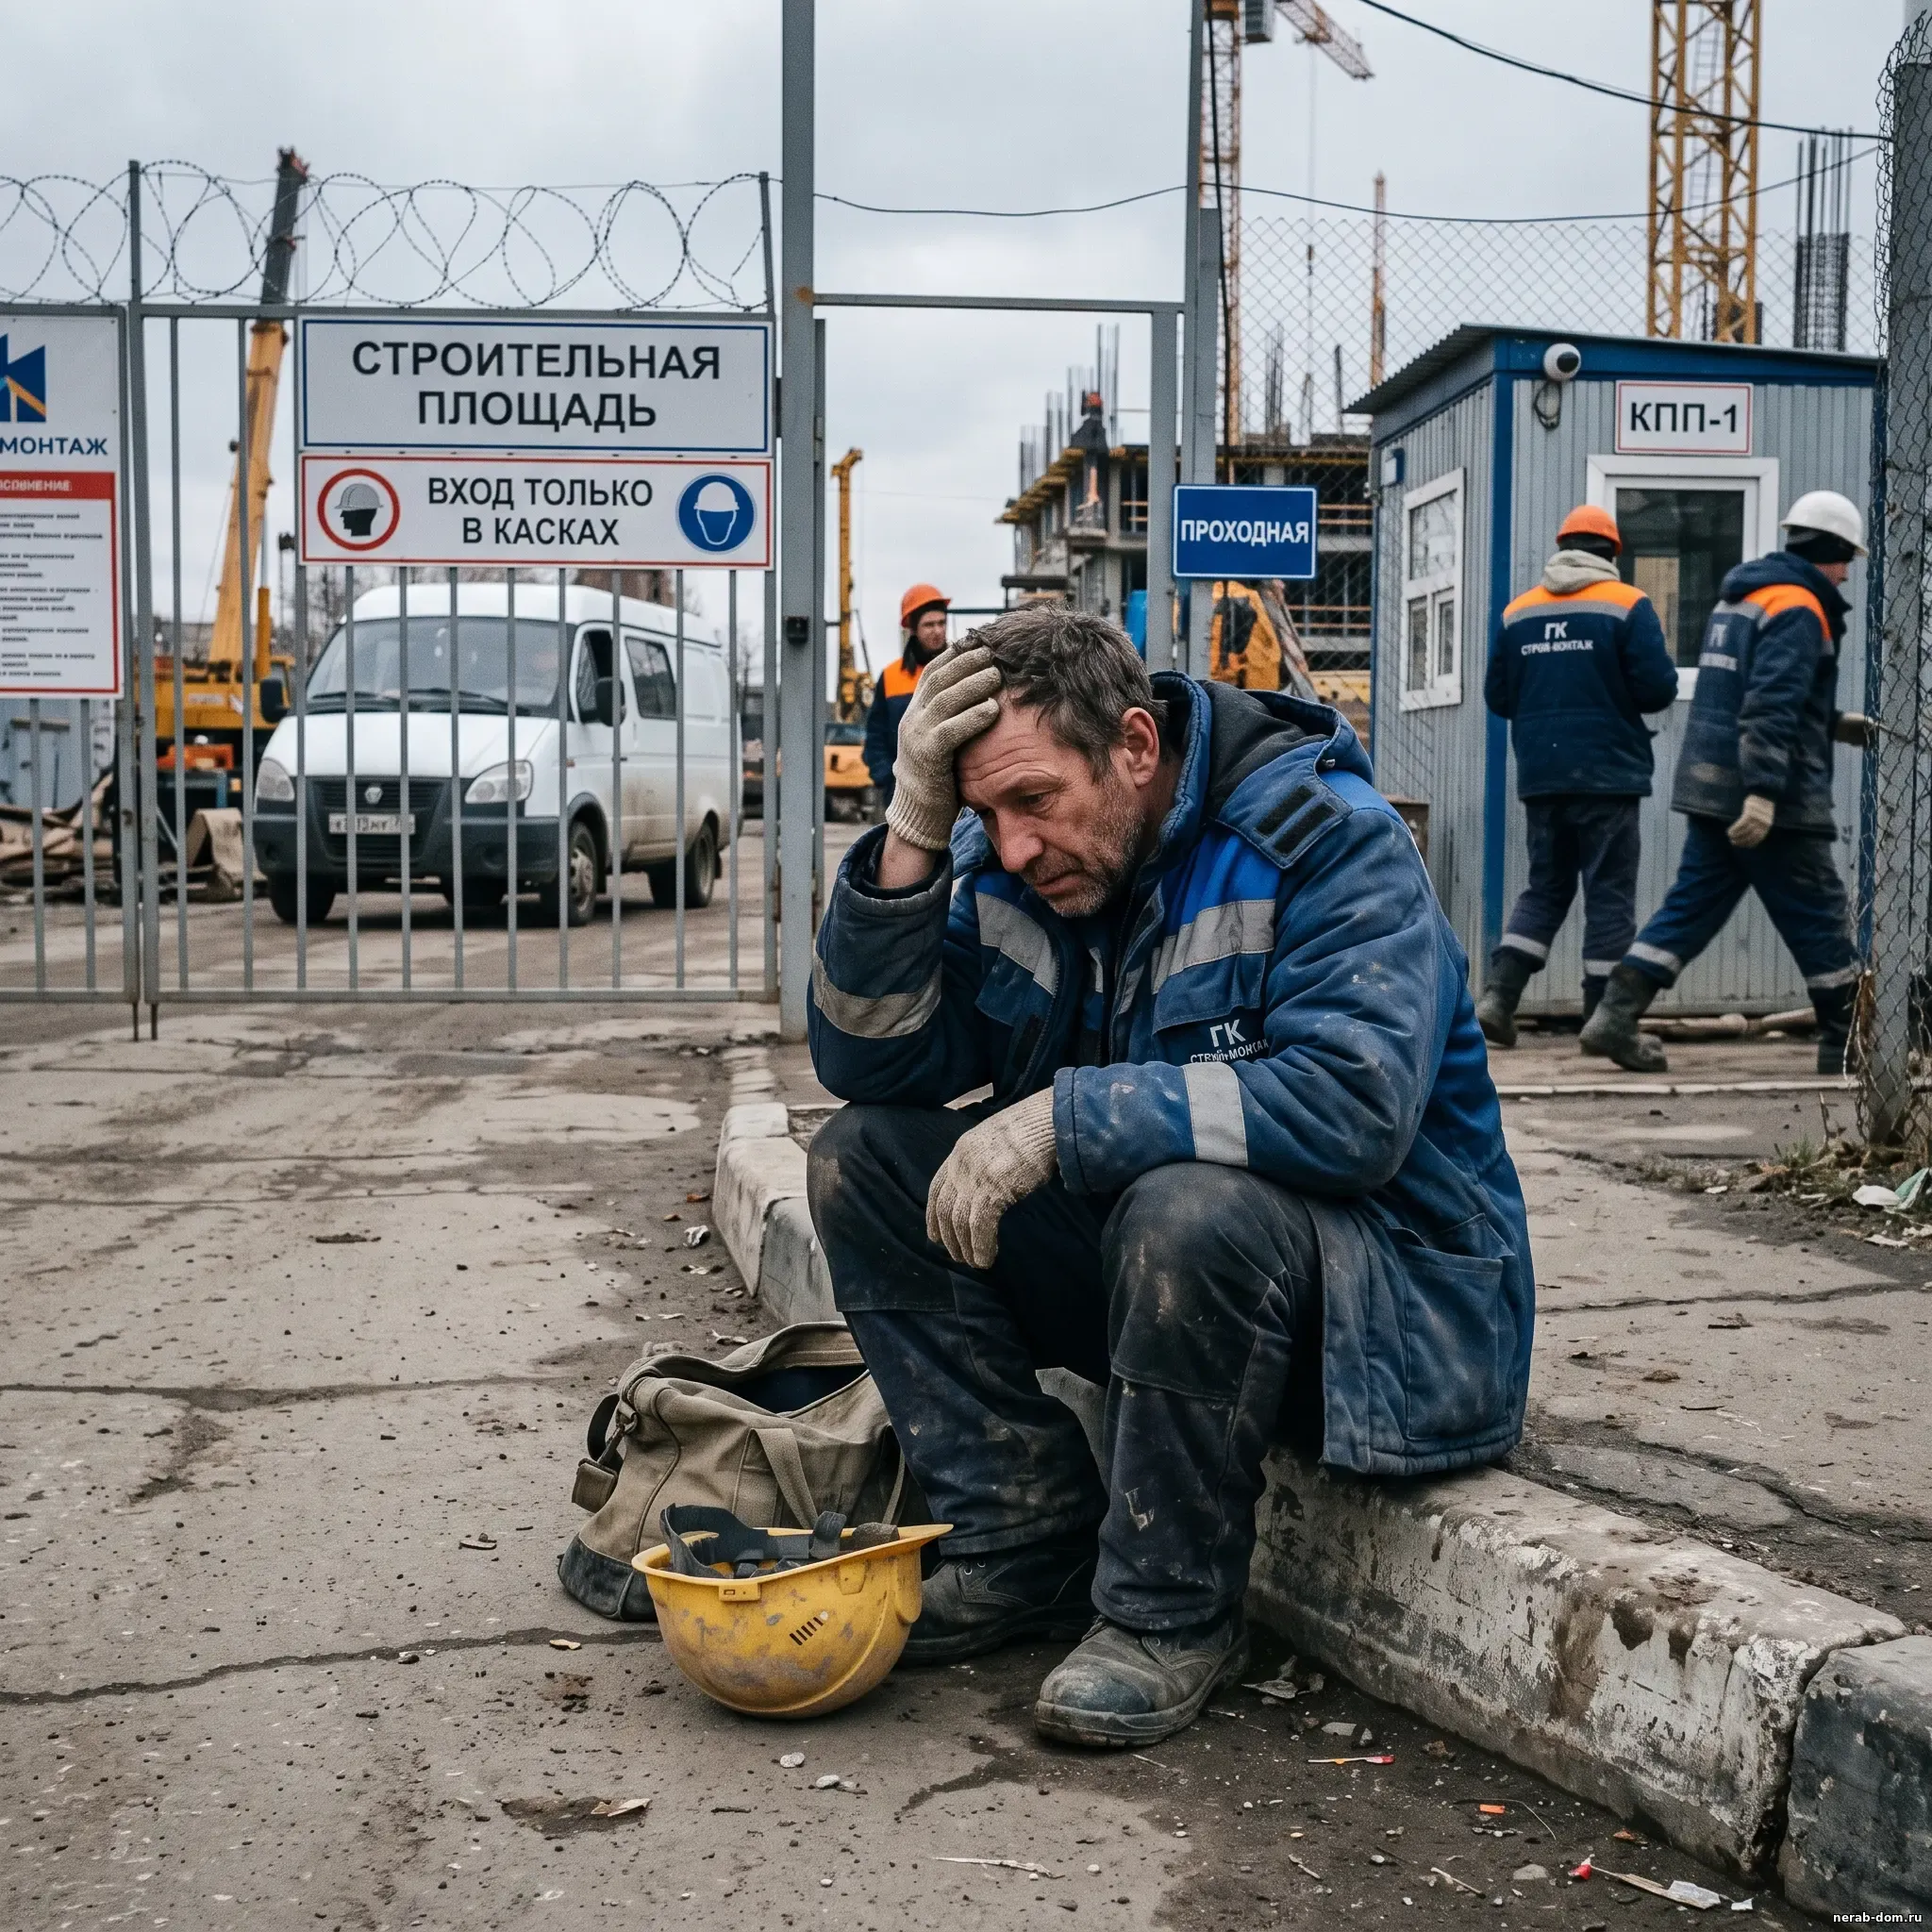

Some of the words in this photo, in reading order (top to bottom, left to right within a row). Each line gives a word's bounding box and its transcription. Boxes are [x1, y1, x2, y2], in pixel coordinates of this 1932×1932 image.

[352, 341, 720, 380] СТРОИТЕЛЬНАЯ
[418, 391, 657, 434] ПЛОЩАДЬ
[1630, 402, 1737, 433] КПП-1
[0, 436, 108, 456] МОНТАЖ
[428, 477, 515, 511] ВХОД
[525, 478, 654, 507] ТОЛЬКО
[462, 517, 483, 544] В
[494, 517, 620, 545] КАСКАХ
[1180, 519, 1309, 547] ПРОХОДНАЯ
[1543, 621, 1569, 641] ГК
[1209, 1019, 1246, 1048] ГК
